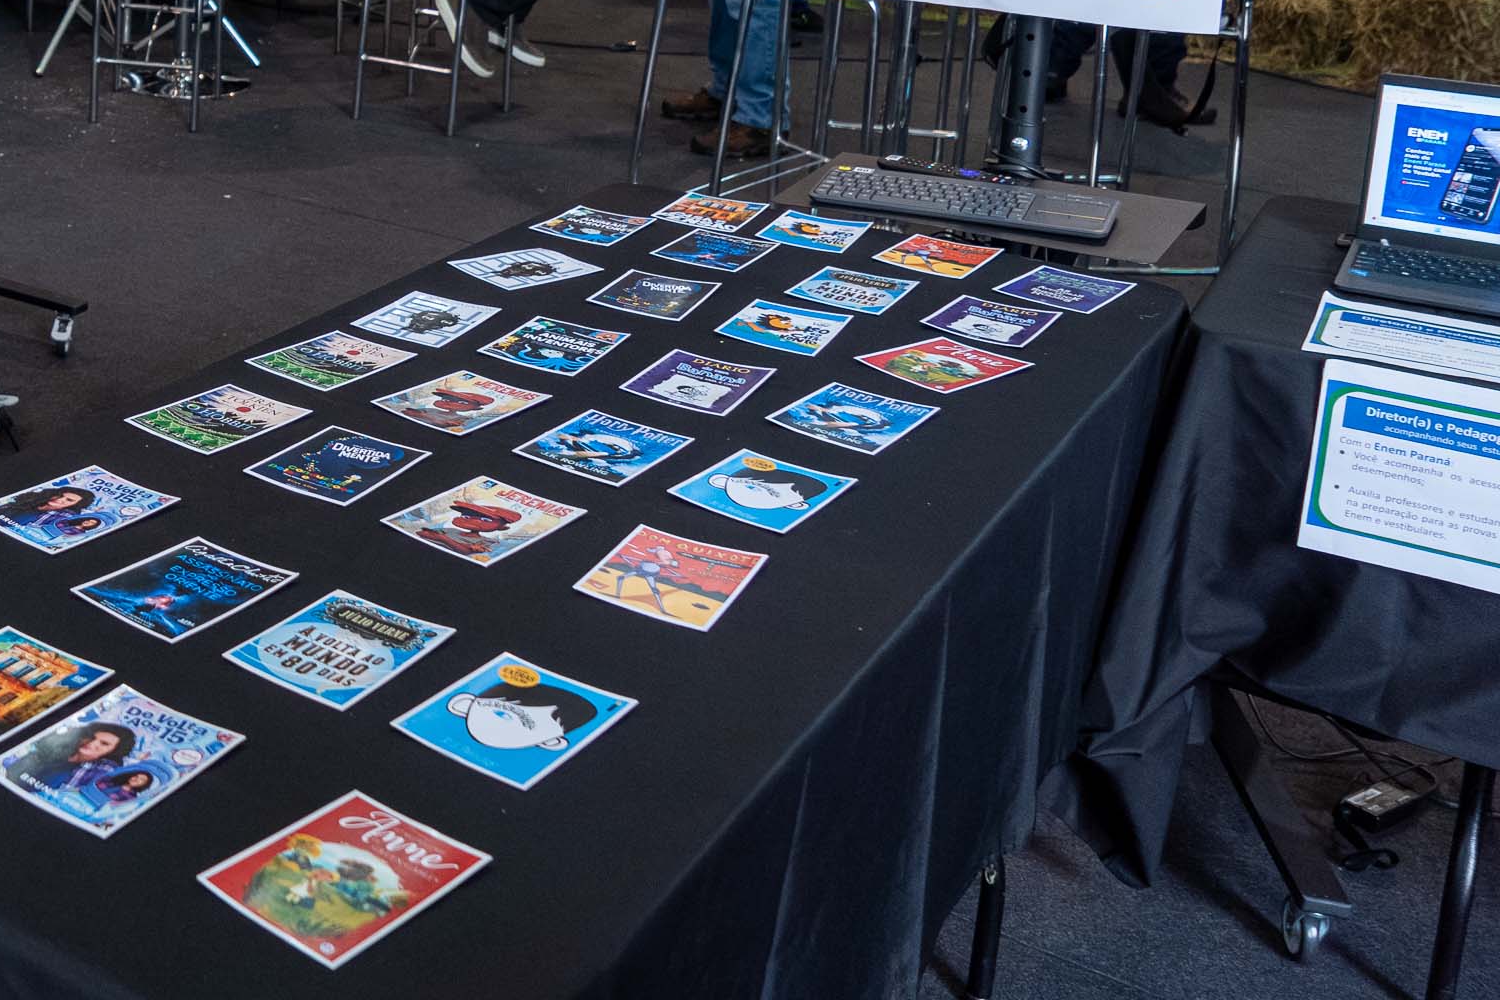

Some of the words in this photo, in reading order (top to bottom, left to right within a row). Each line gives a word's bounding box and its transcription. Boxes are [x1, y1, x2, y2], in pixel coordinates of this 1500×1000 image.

[1407, 127, 1449, 142] ENEM
[817, 285, 879, 302] MUNDO
[822, 292, 846, 302] 80
[522, 333, 606, 356] INVENTORES
[538, 331, 597, 348] ANIMAIS
[474, 380, 539, 402] JEREMIAS
[828, 386, 879, 405] Harry
[879, 397, 930, 418] Potter
[186, 403, 200, 412] O
[199, 407, 258, 431] HOBBIT
[585, 413, 635, 433] Harry
[633, 424, 684, 449] Potter
[1365, 406, 1432, 431] Diretor(a)
[1434, 422, 1443, 432] e
[331, 442, 391, 461] DIVERTIDA
[1339, 435, 1363, 450] Com
[1363, 441, 1372, 450] o
[1373, 441, 1407, 458] Enem
[1383, 424, 1455, 448] acompanhando
[1456, 440, 1478, 452] seus
[337, 450, 381, 464] MENTE
[559, 457, 610, 477] ROWLING
[1353, 450, 1378, 467] Você
[1383, 457, 1445, 479] acompanha
[1450, 472, 1463, 482] os
[1351, 463, 1426, 487] desempenhos;
[113, 492, 138, 505] 15
[494, 488, 575, 517] JEREMIAS
[1348, 485, 1382, 502] Auxilia
[1384, 491, 1445, 515] professores
[1447, 508, 1455, 517] e
[1343, 509, 1374, 525] Enem
[1373, 517, 1382, 526] e
[1382, 519, 1447, 541] vestibulares.
[1345, 498, 1359, 509] na
[1361, 500, 1419, 522] preparação
[1420, 513, 1445, 528] para
[1446, 520, 1460, 530] as
[1461, 523, 1498, 540] provas
[163, 572, 224, 601] ORIENTE
[168, 564, 238, 598] EXPRESSO
[175, 553, 264, 593] ASSASSINATO
[338, 608, 374, 628] JÚLIO
[371, 621, 411, 641] VERNE
[283, 635, 370, 676] MUNDO
[299, 625, 316, 637] A
[312, 632, 361, 657] VOLTA
[362, 653, 387, 666] AO
[264, 643, 284, 659] EM
[280, 655, 318, 675] 80
[316, 668, 357, 687] DIAS
[157, 713, 209, 737] Volta
[157, 726, 186, 745] 15
[338, 810, 460, 871] Anne
